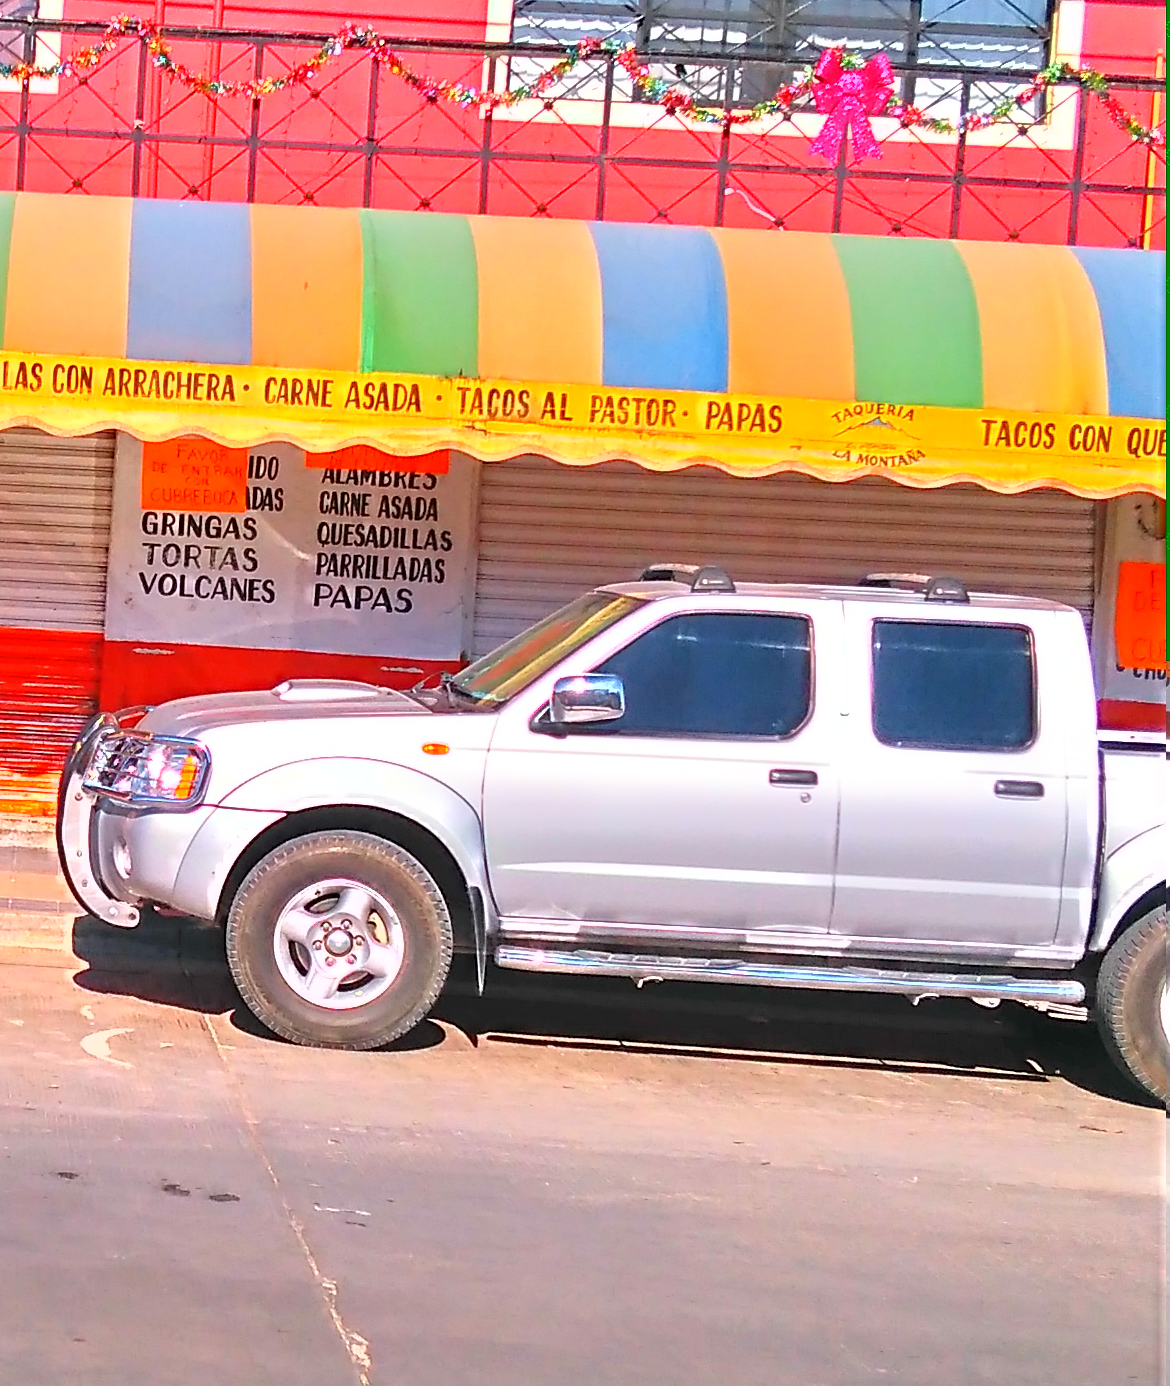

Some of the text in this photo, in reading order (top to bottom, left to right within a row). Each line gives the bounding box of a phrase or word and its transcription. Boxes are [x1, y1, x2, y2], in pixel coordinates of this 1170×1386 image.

[52, 364, 93, 395] CON
[102, 368, 235, 402] ARRACHERA
[264, 376, 334, 408] CARNE
[344, 381, 422, 413] ASADA
[457, 386, 530, 419] TACOS
[541, 392, 573, 422] AL
[589, 395, 677, 427] PASTOR
[705, 400, 782, 433] PAPAS
[981, 419, 1055, 450] TACOS
[1069, 424, 1113, 453] CON
[319, 491, 438, 522] CARNE ASADA
[141, 512, 257, 541] GRINGAS
[317, 521, 453, 551] QUESADILLAS
[142, 542, 258, 573] TORTAS
[315, 553, 445, 584] PARRILLADAS
[139, 572, 276, 604] VOLCANES
[313, 584, 413, 614] PAPAS
